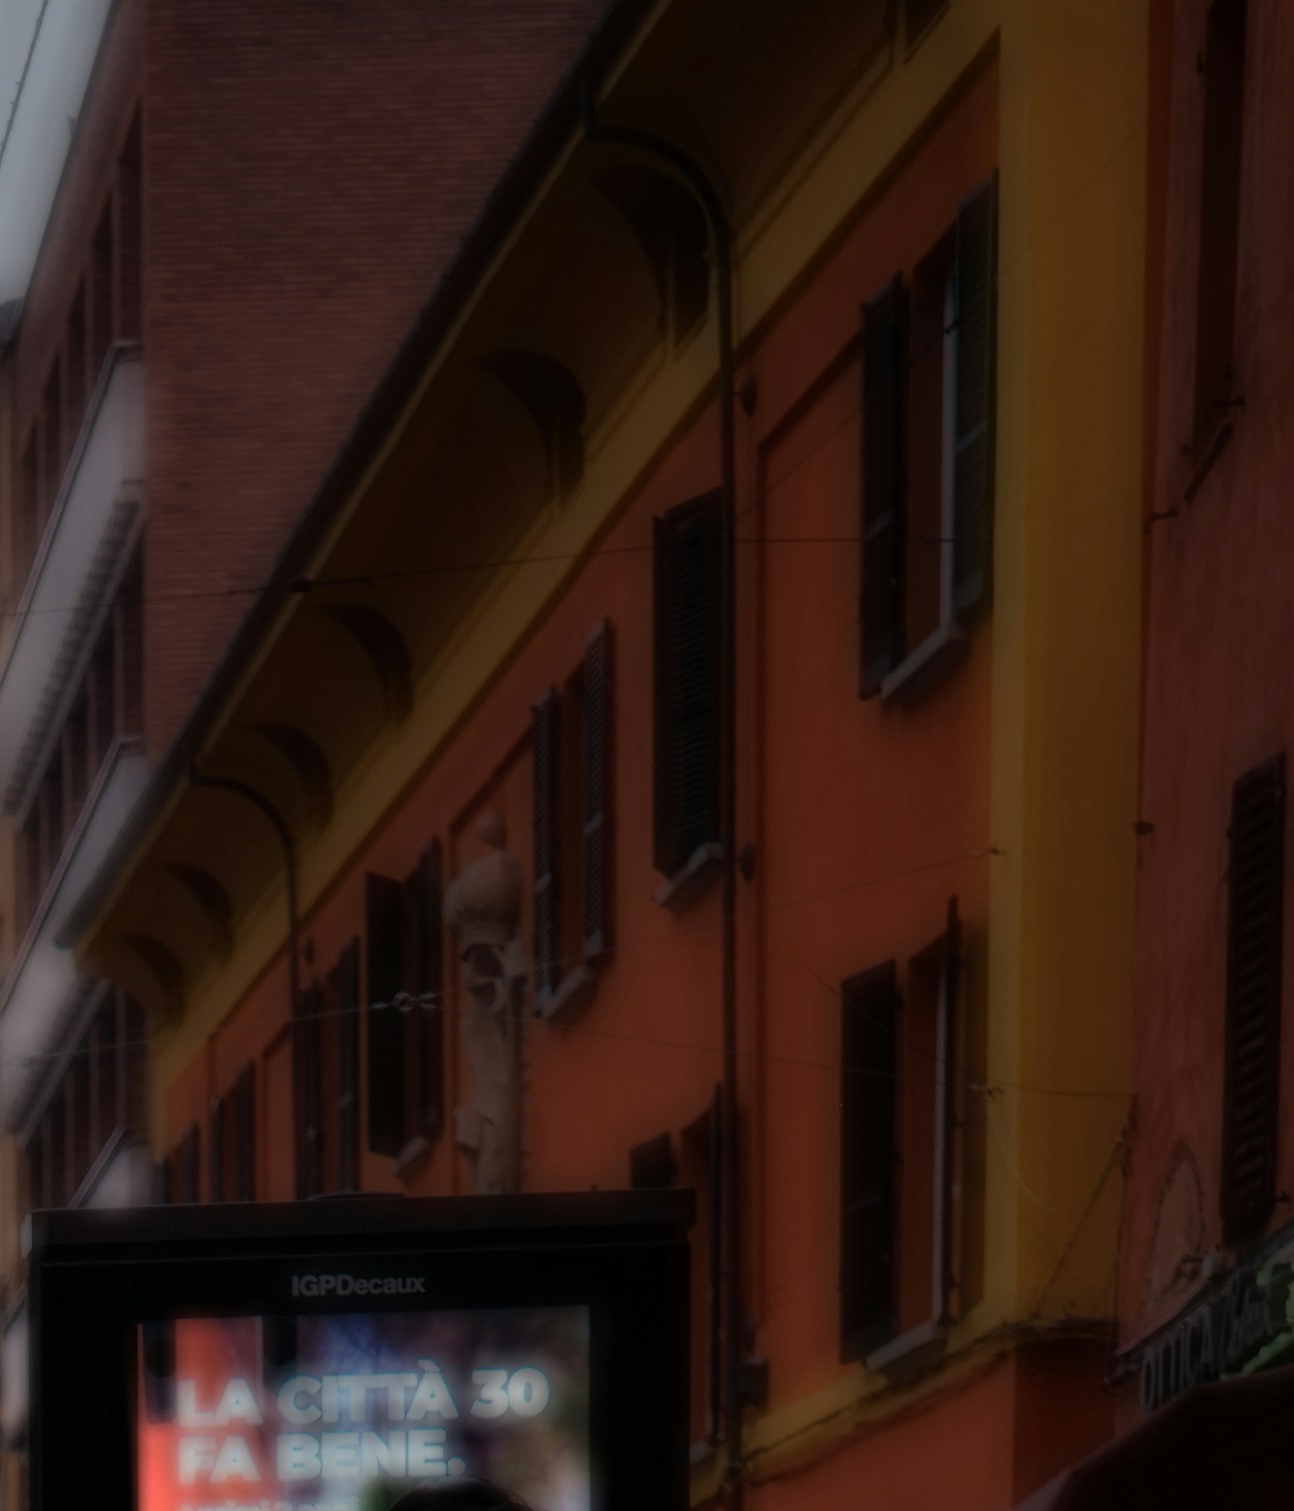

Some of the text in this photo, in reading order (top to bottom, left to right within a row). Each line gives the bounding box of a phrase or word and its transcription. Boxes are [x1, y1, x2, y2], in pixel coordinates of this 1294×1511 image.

[291, 1273, 427, 1297] IGPDecaux
[178, 1358, 550, 1428] LA CITTÀ 30
[178, 1428, 467, 1484] FA BENE.
